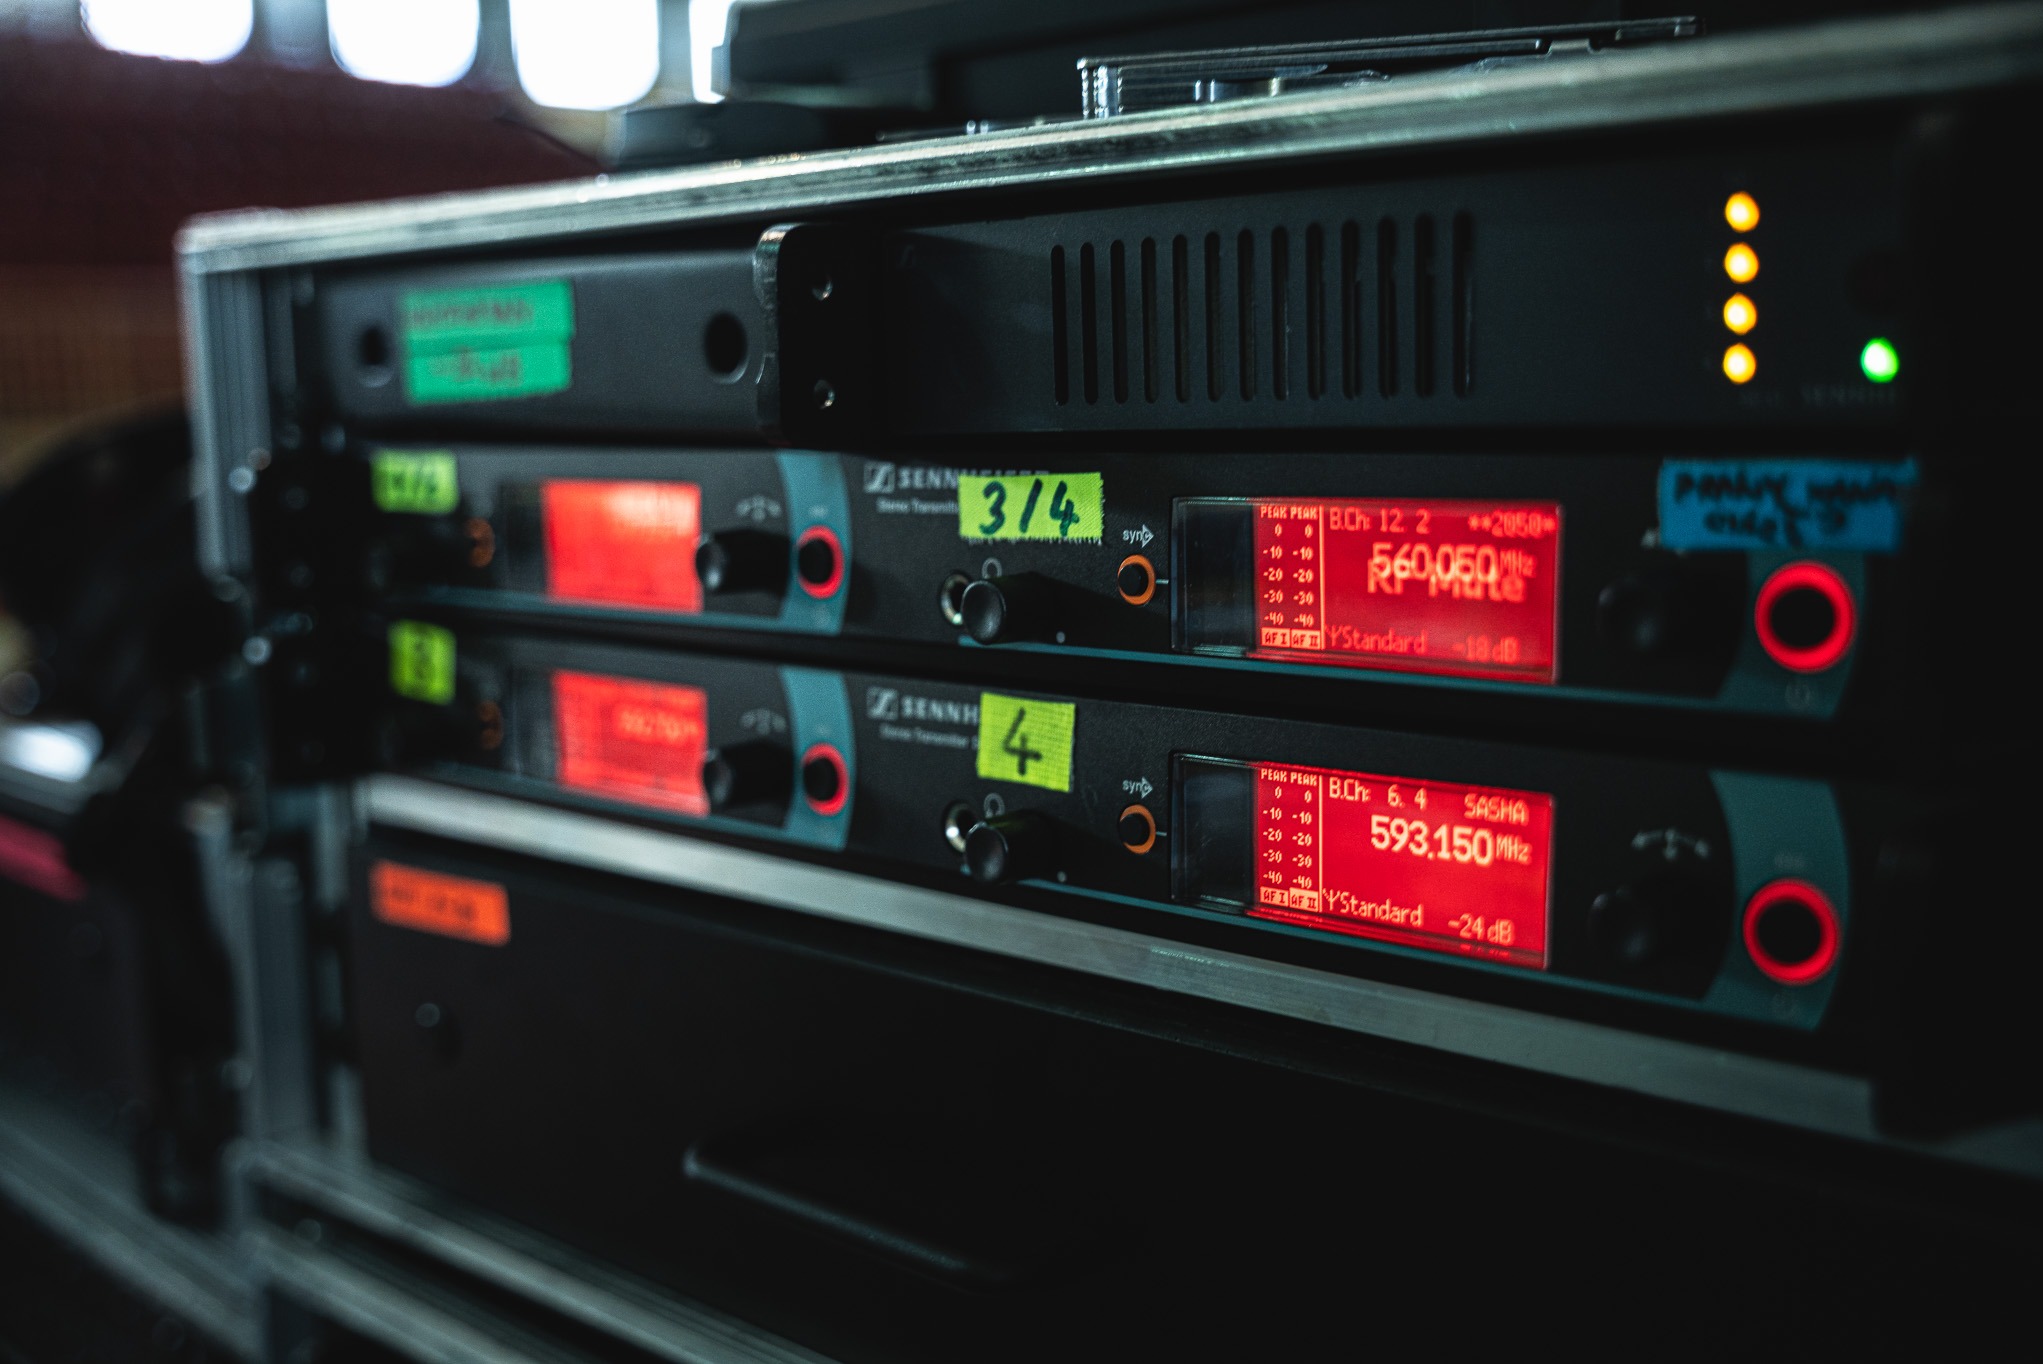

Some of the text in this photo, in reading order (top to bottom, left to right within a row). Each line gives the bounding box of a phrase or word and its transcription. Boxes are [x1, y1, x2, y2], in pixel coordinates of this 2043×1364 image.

[1261, 506, 1318, 519] PEAK PEAK
[1415, 508, 1431, 534] 2
[1122, 529, 1149, 544] sync
[1275, 524, 1313, 538] 0 0
[1263, 546, 1313, 560] -10 -10
[1263, 568, 1314, 583] -20 -20
[1264, 590, 1314, 605] -30 -30
[1264, 612, 1314, 627] -40 -40
[1342, 625, 1428, 654] Standard
[1003, 707, 1042, 775] 4
[1261, 768, 1317, 786] PEAK PEAK
[1122, 779, 1147, 794] sync
[1275, 786, 1312, 803] 0 0
[1263, 807, 1312, 825] -10 -10
[1414, 788, 1427, 810] 4
[1464, 792, 1530, 826] SASHA
[1263, 828, 1312, 846] -20 -20
[1370, 814, 1533, 867] 593.150 MHz
[1263, 849, 1312, 868] -30 -30
[1263, 871, 1312, 889] -40 -40
[1340, 890, 1515, 946] Standard -24 dB
